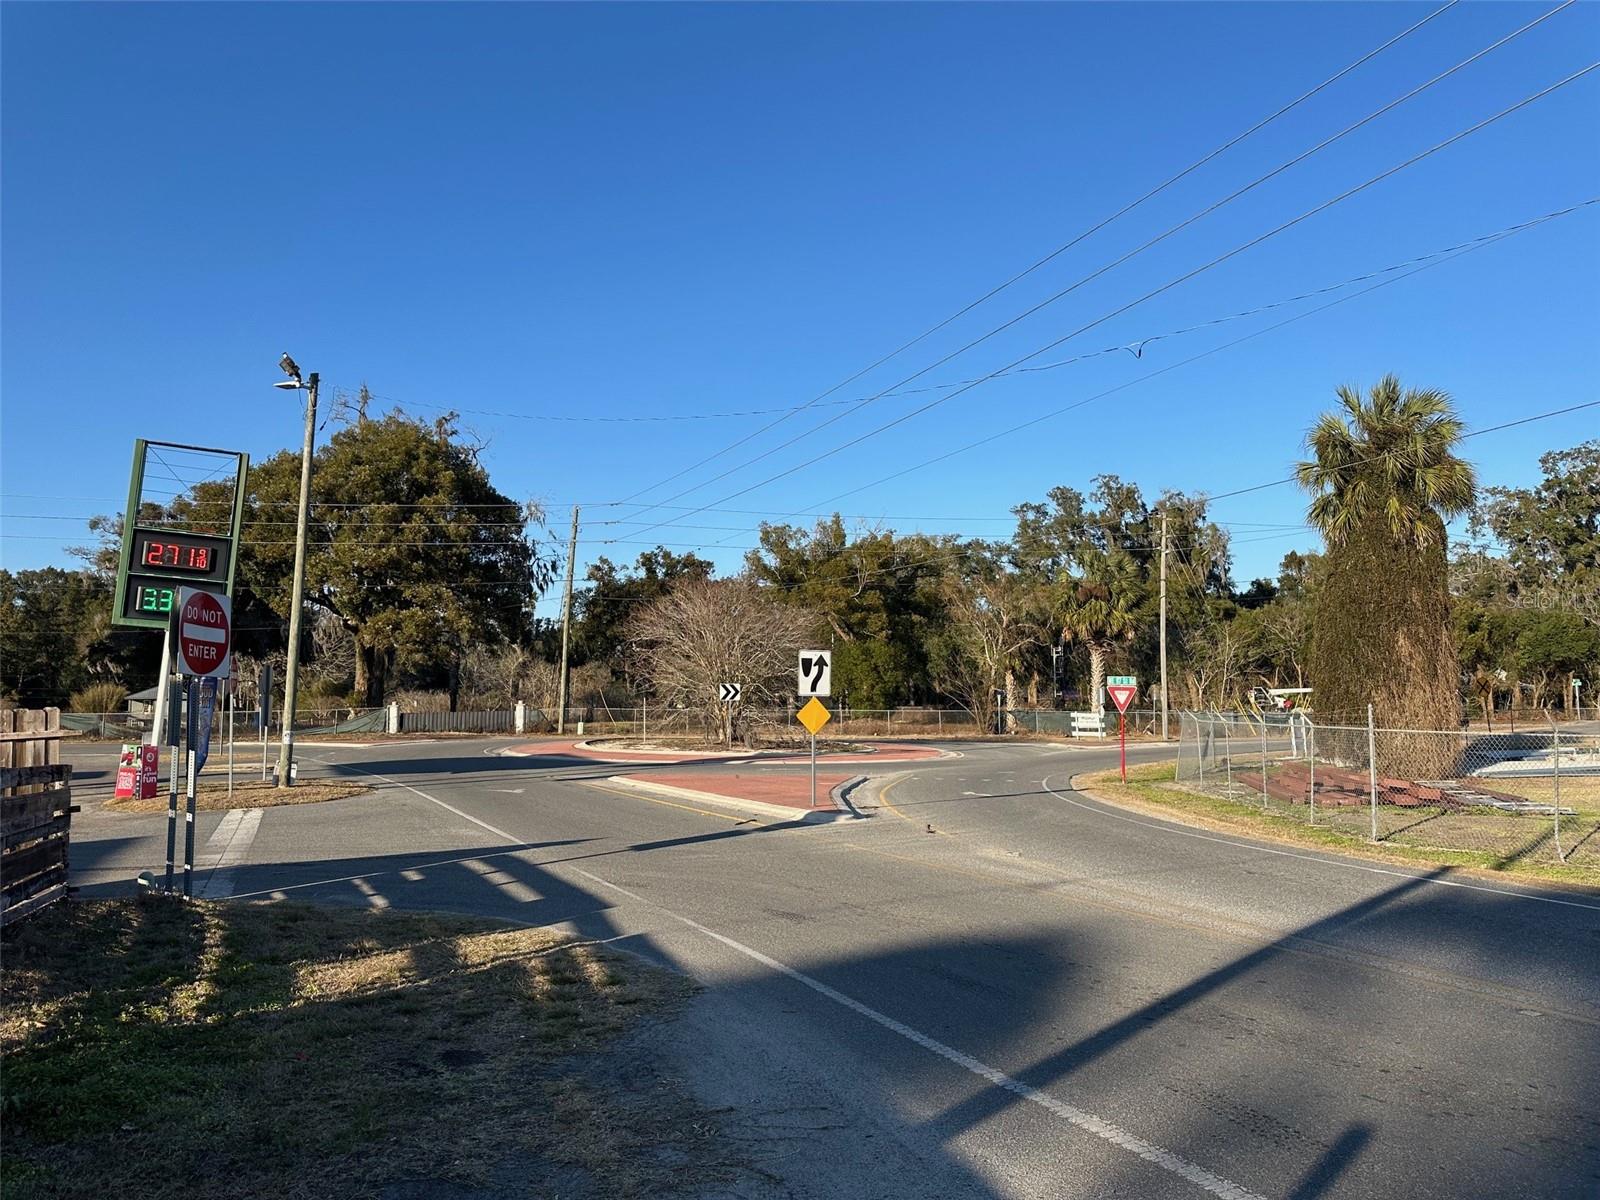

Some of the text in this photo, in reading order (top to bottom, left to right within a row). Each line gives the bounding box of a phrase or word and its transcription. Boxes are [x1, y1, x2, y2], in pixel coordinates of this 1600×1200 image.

[143, 588, 173, 611] 3.3
[187, 606, 223, 624] DO NOT
[188, 643, 217, 660] ENTER
[142, 773, 157, 783] fun
